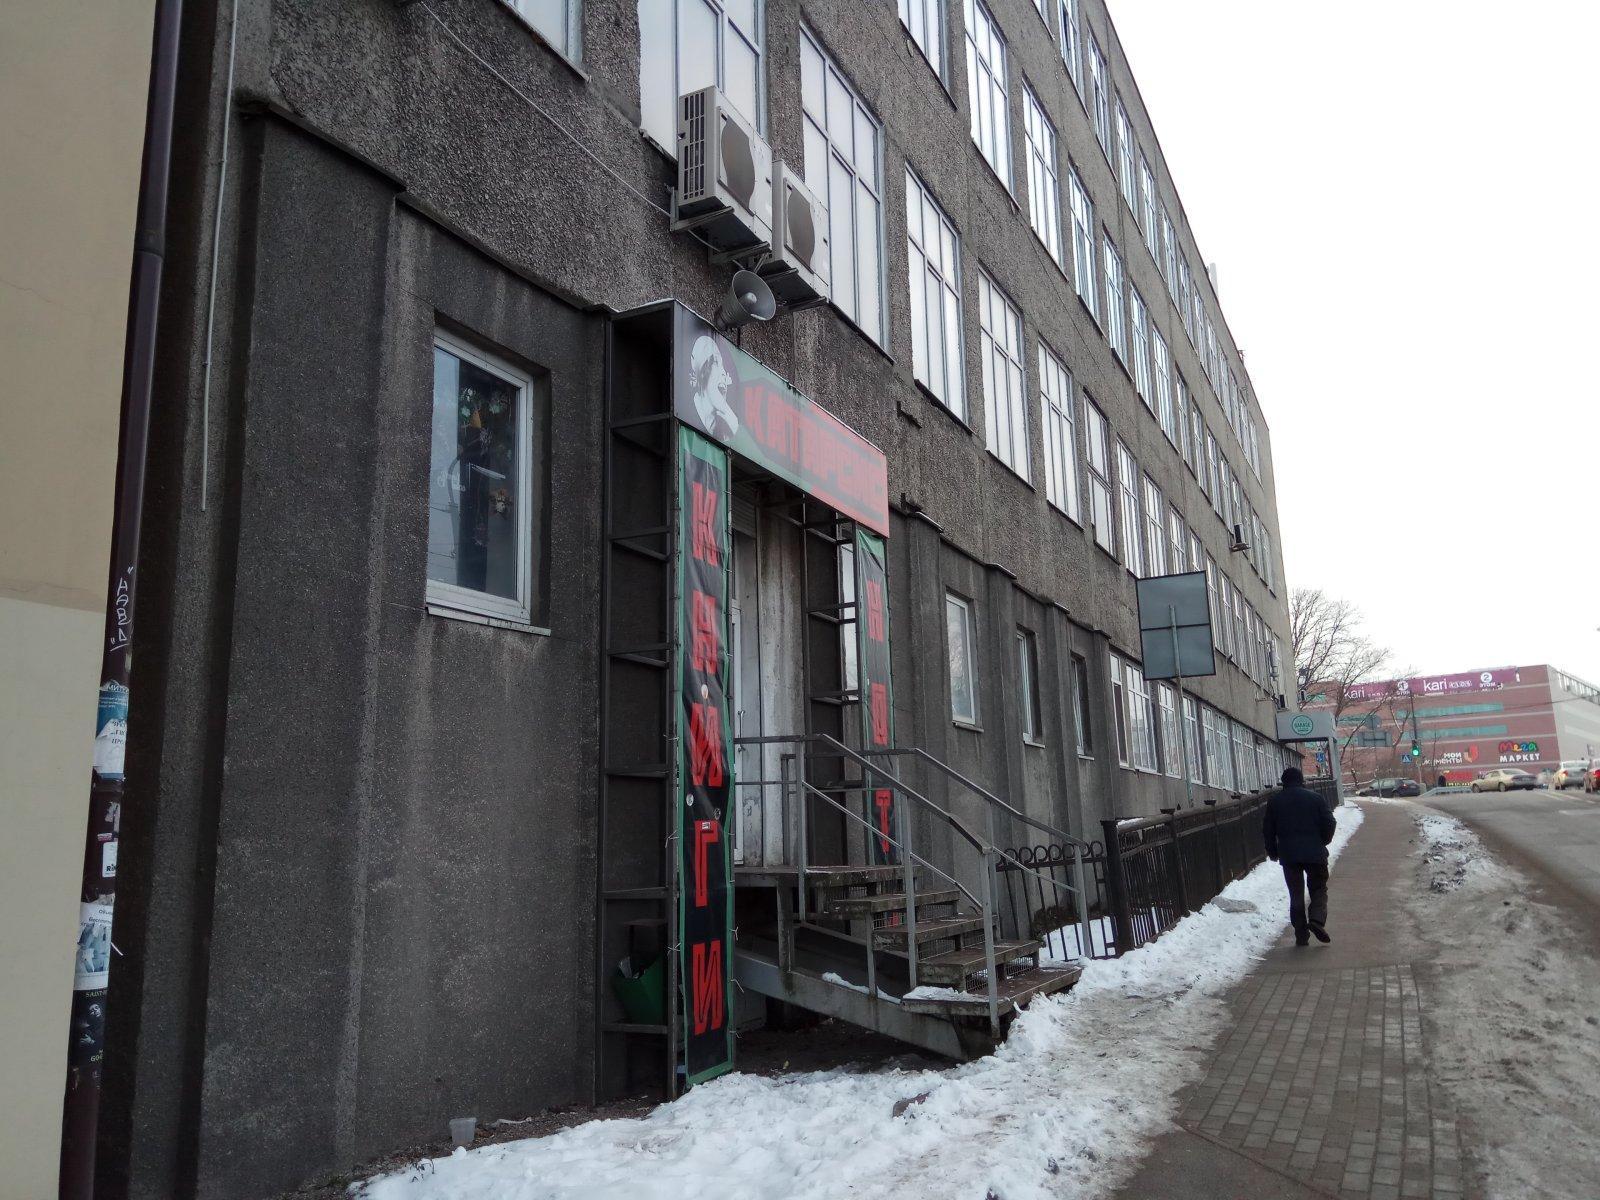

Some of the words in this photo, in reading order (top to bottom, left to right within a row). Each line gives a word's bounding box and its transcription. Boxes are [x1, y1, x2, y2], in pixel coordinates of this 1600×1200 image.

[690, 480, 724, 1036] КНИГИ
[867, 580, 899, 928] НОТ
[1423, 678, 1447, 692] kari
[1500, 753, 1540, 763] МАРКЕТ
